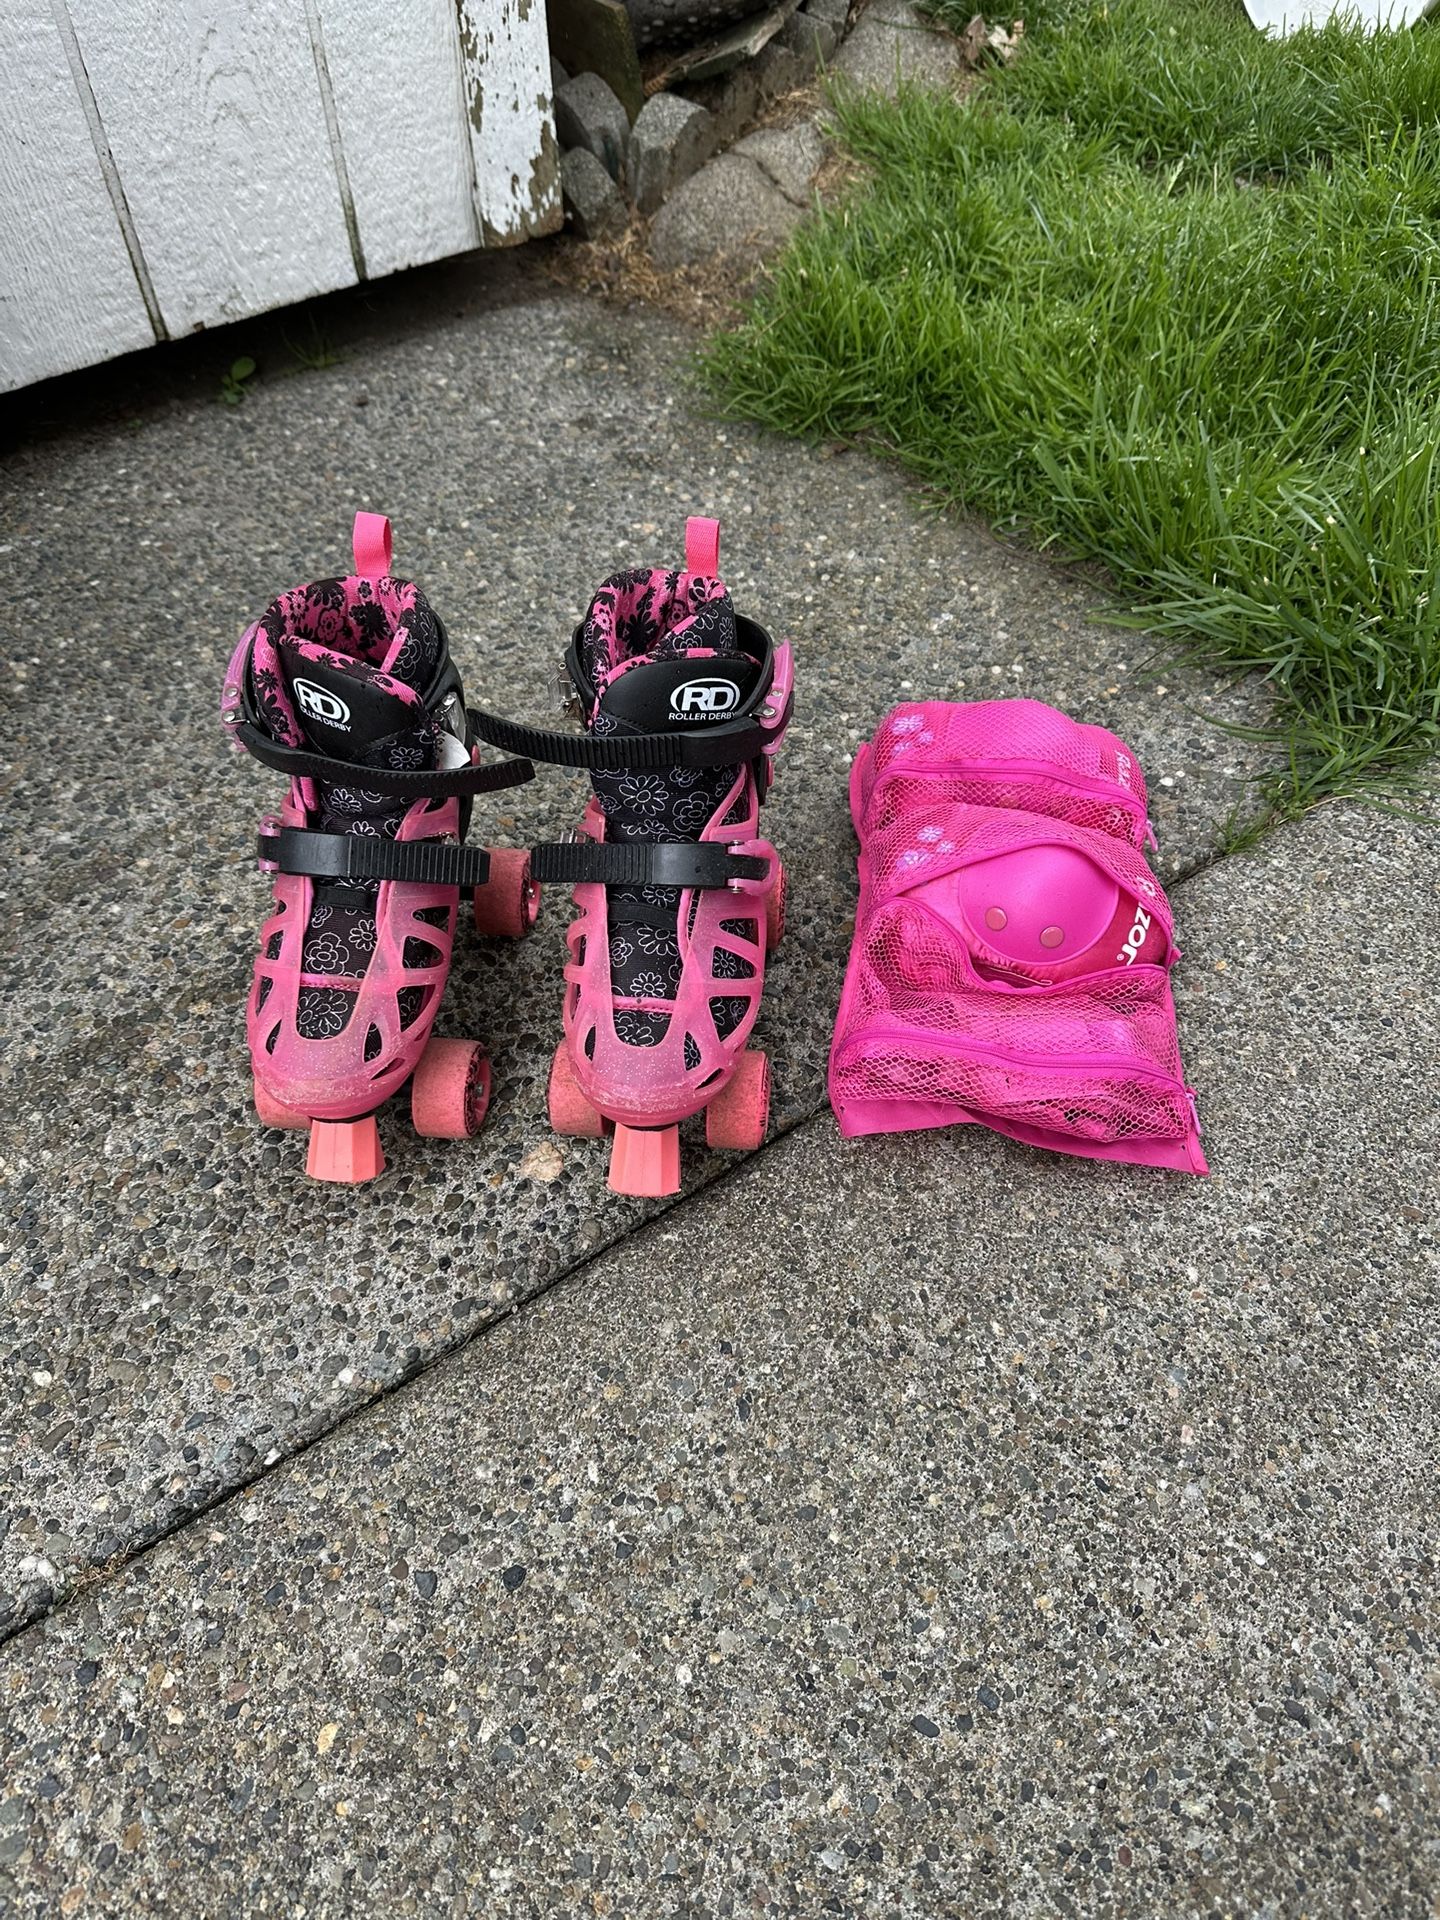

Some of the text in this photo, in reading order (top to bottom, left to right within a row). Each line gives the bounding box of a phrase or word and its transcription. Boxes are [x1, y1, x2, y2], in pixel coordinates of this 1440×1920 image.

[297, 682, 343, 720] RD
[681, 686, 735, 711] RD
[300, 704, 352, 733] OLLER DERBY
[668, 711, 737, 721] ROLLER DERBY
